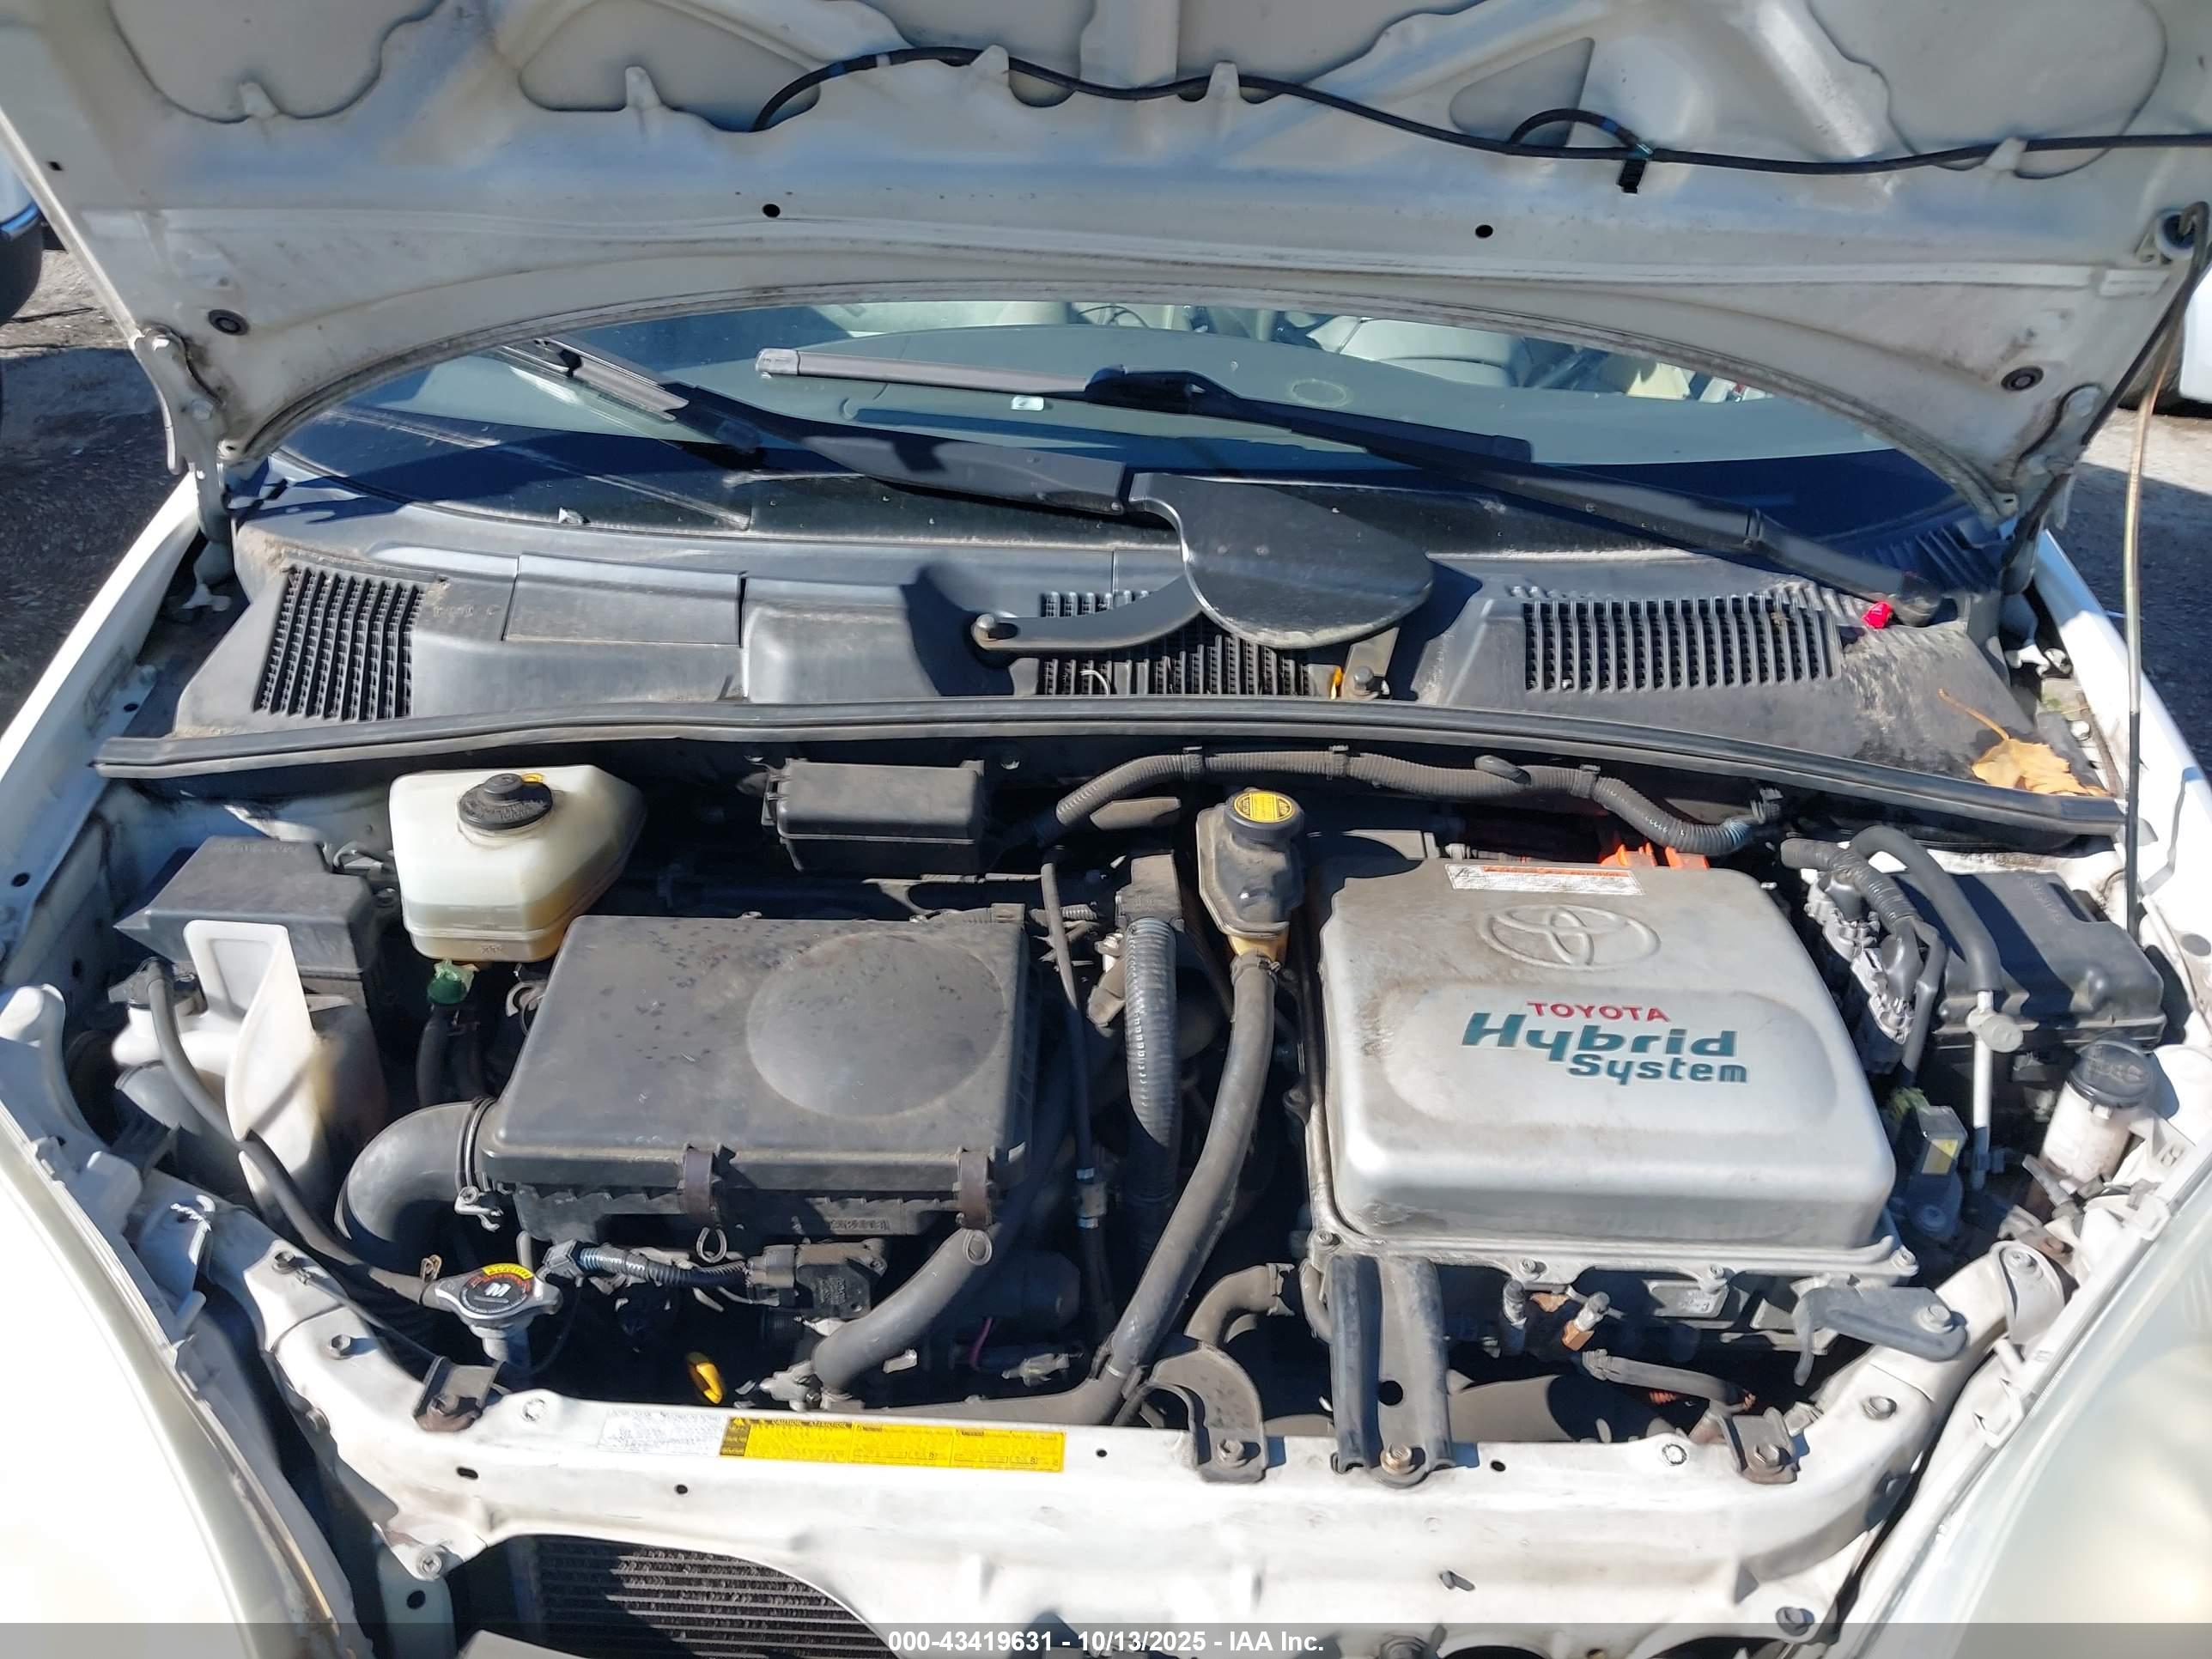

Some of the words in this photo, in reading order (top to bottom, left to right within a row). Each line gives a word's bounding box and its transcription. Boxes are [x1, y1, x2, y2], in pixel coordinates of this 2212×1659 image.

[1527, 1001, 1669, 1023] TOYOTA
[1462, 1012, 1737, 1062] Hybrid
[1569, 1054, 1747, 1085] System
